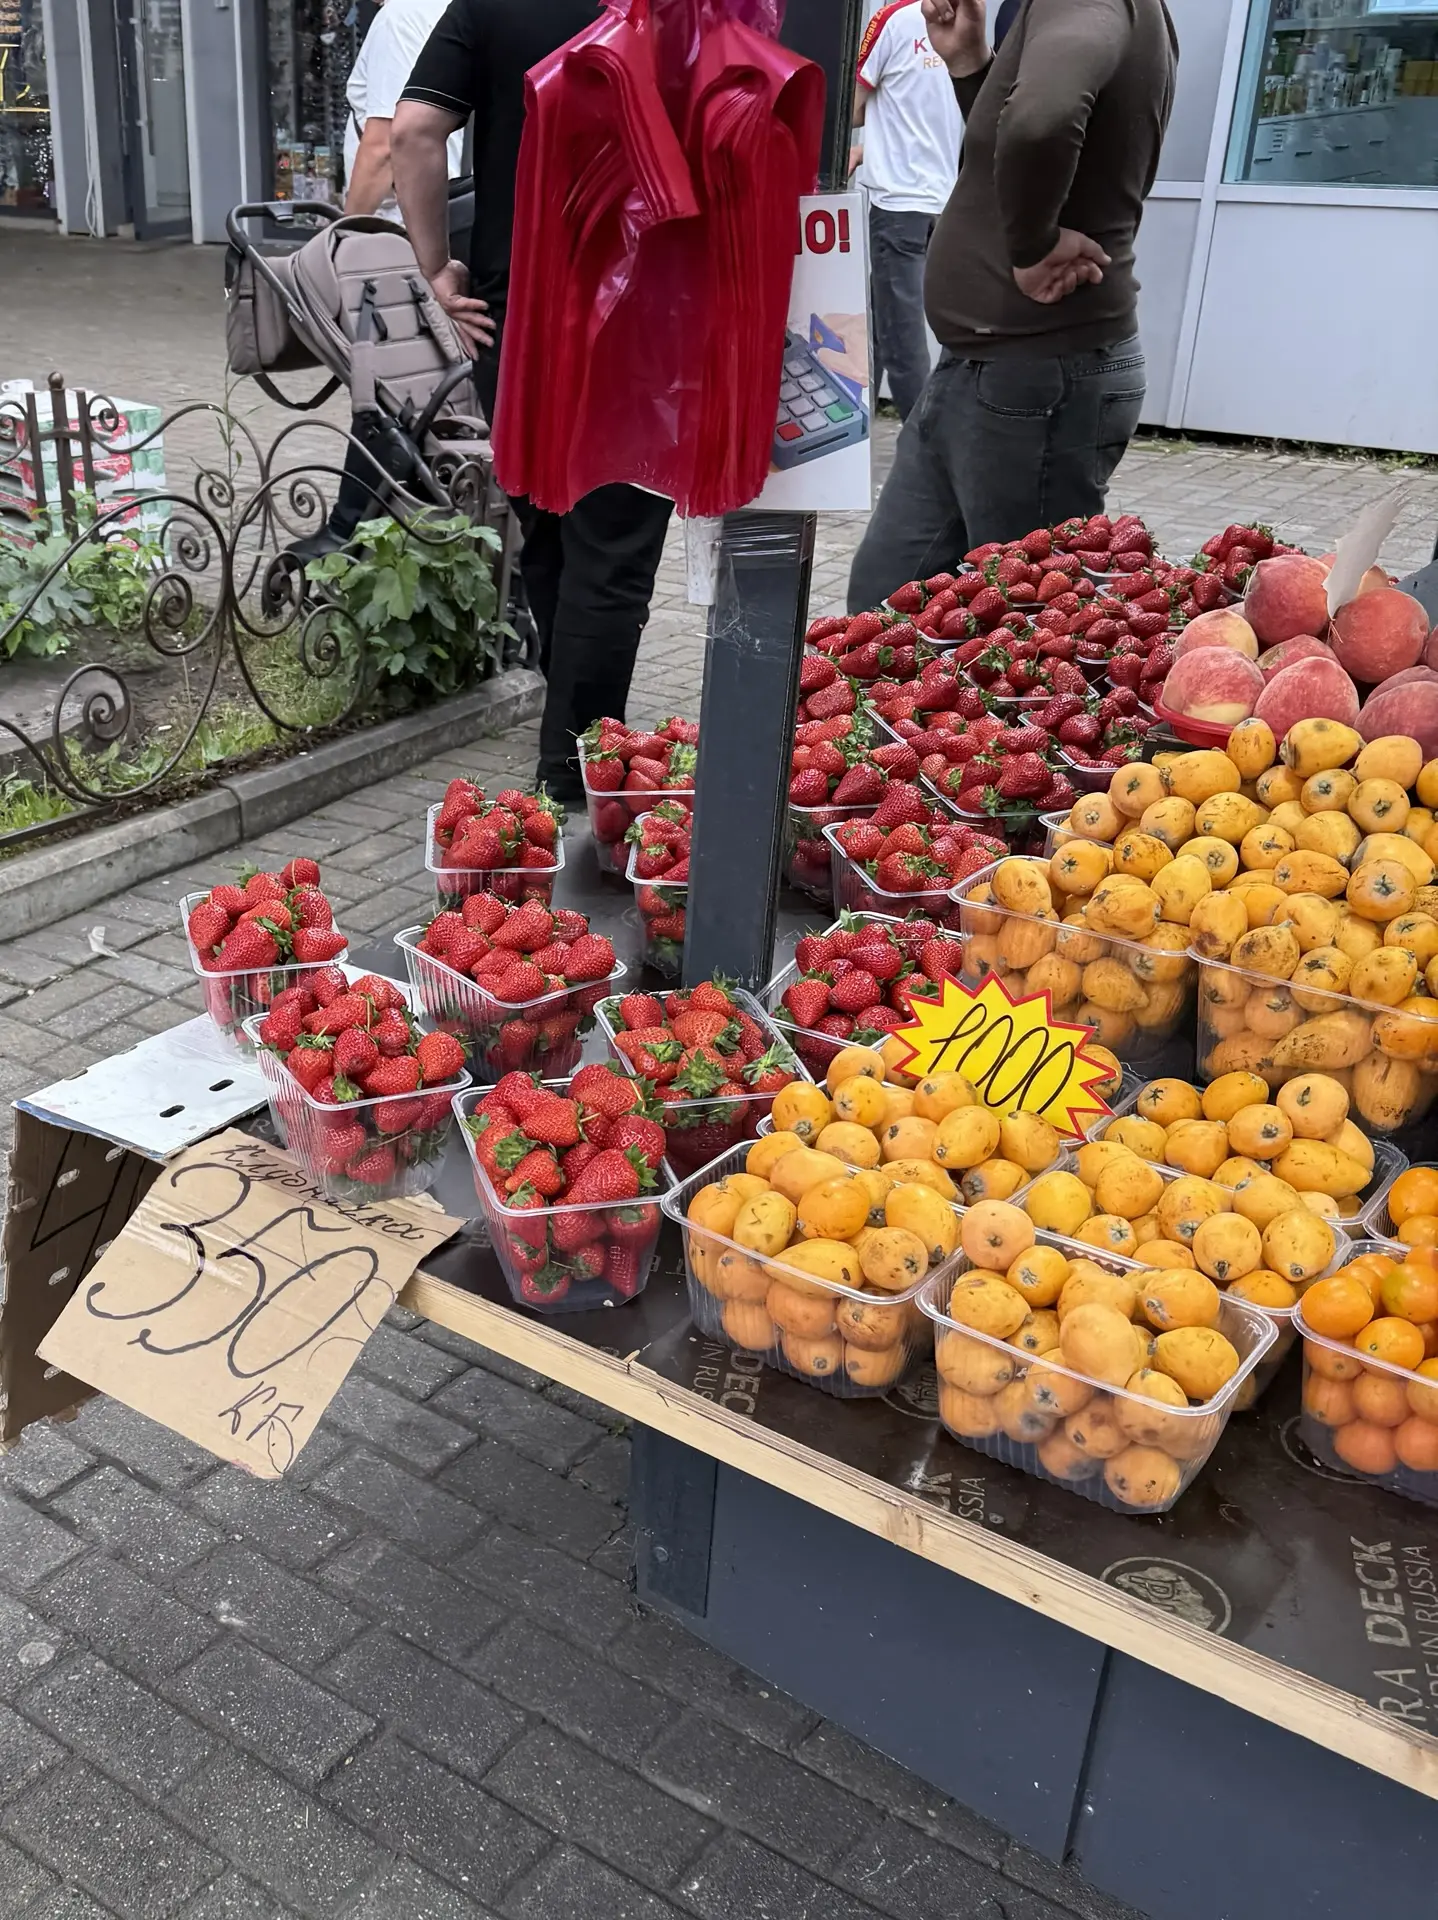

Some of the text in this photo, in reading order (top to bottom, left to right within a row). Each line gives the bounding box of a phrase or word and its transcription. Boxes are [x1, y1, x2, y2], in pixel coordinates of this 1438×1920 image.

[913, 37, 928, 55] K
[794, 208, 851, 256] О!
[86, 1162, 379, 1379] 350
[701, 1341, 727, 1362] IN
[720, 1350, 765, 1420] DEC
[958, 1477, 986, 1525] SSIA
[1401, 1545, 1438, 1624] RUSSIA
[1350, 1535, 1427, 1722] RA DECK
